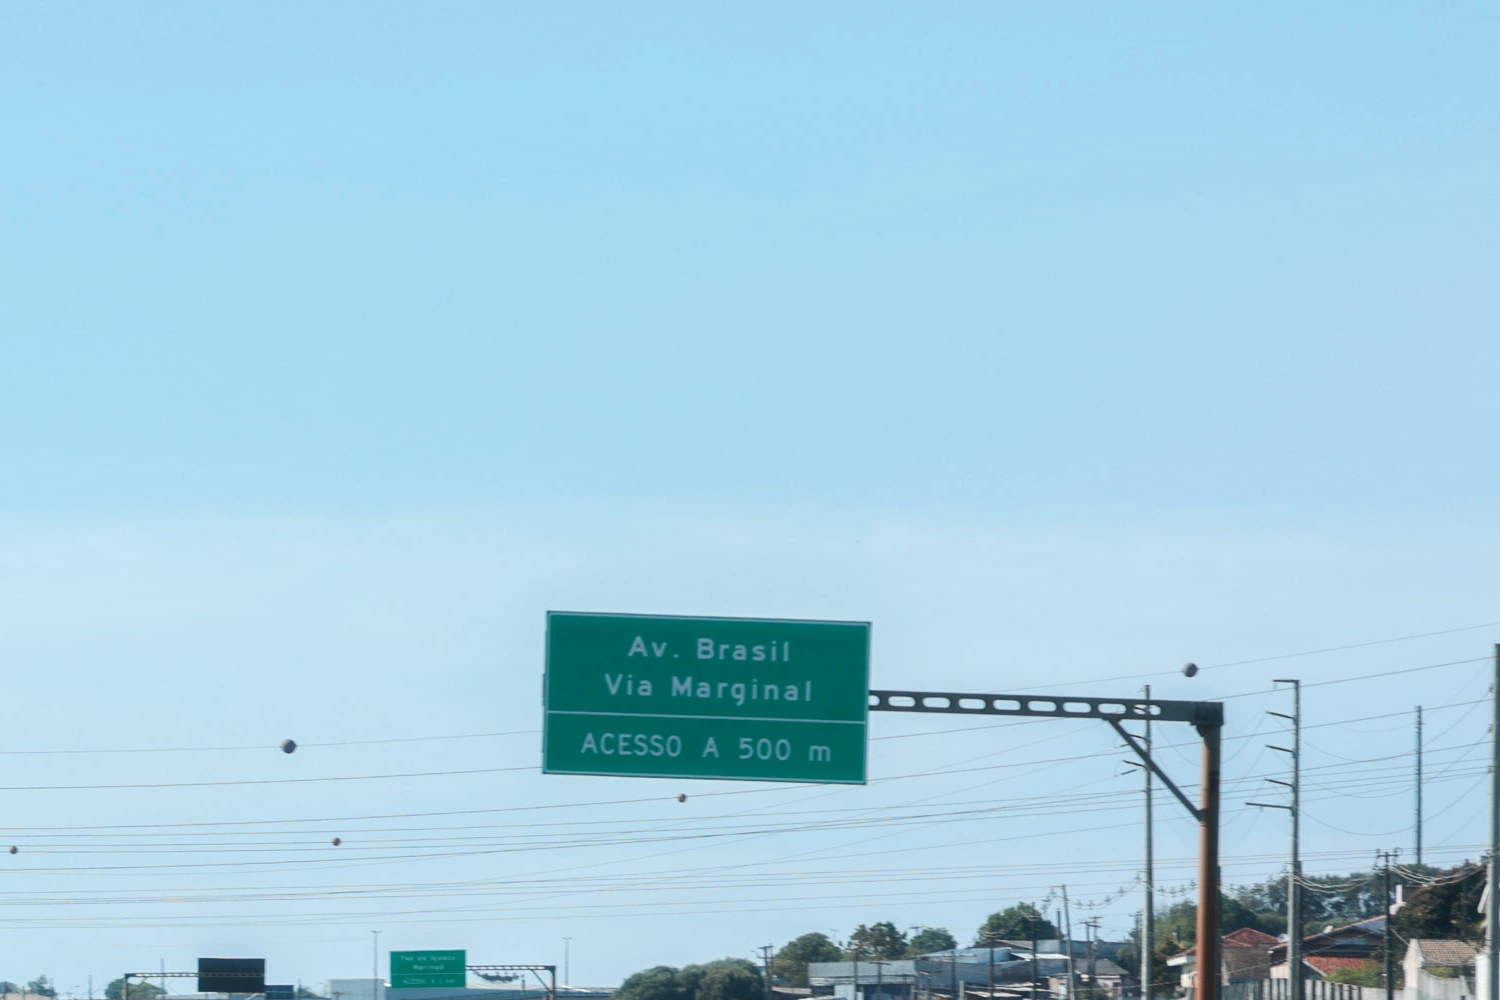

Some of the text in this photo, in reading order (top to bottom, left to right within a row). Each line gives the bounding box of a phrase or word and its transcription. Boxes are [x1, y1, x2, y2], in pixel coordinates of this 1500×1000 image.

[627, 635, 790, 662] Av. Brasil
[604, 673, 813, 706] Via Marginal
[580, 732, 832, 762] ACESSO A 500 m
